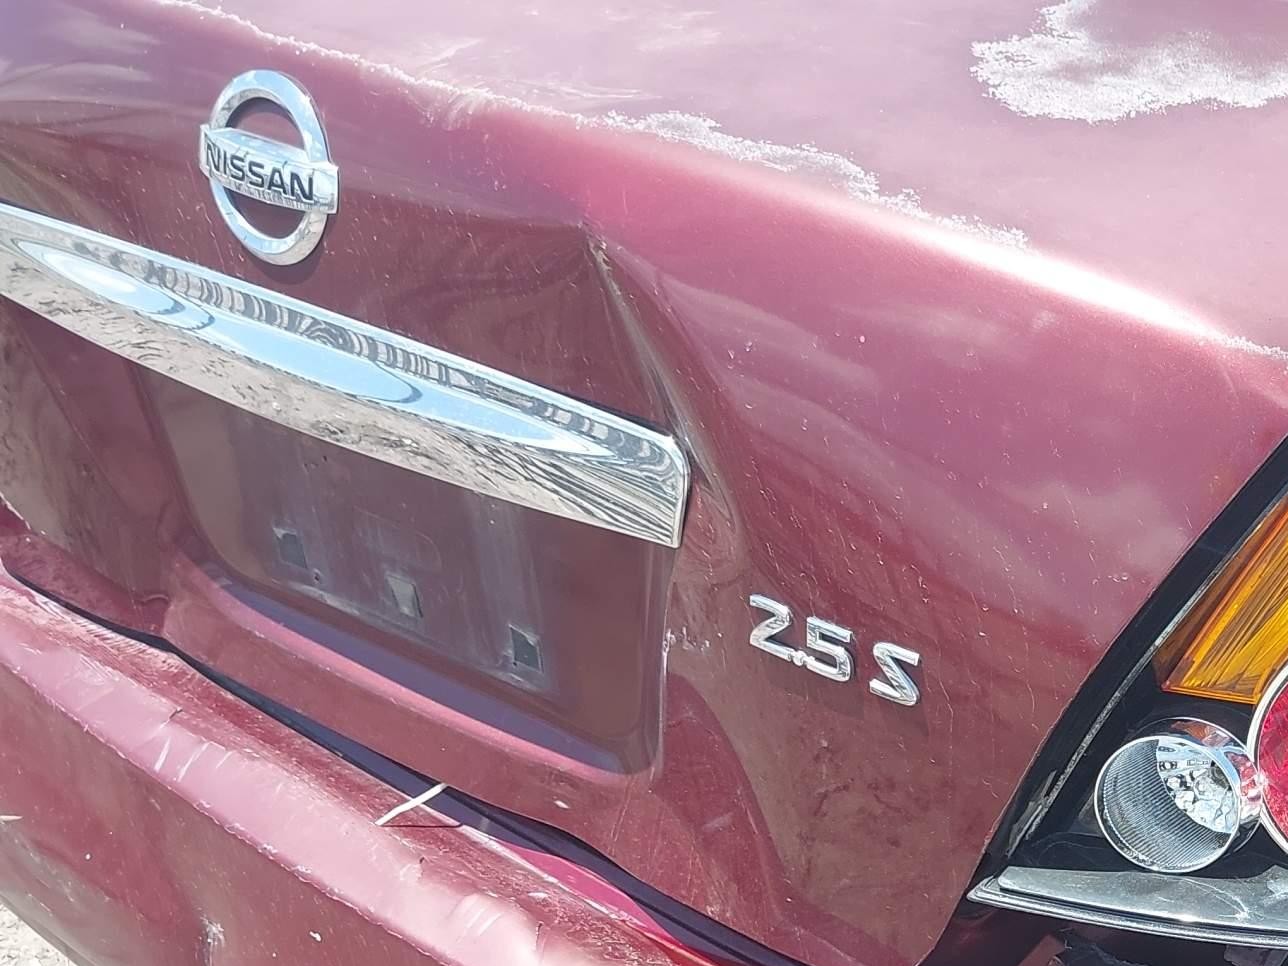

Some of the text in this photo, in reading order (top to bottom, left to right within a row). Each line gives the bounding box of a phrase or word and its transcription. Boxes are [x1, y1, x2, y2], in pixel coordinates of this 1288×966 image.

[205, 139, 314, 201] NISSAN
[749, 593, 921, 706] 2.5 S
